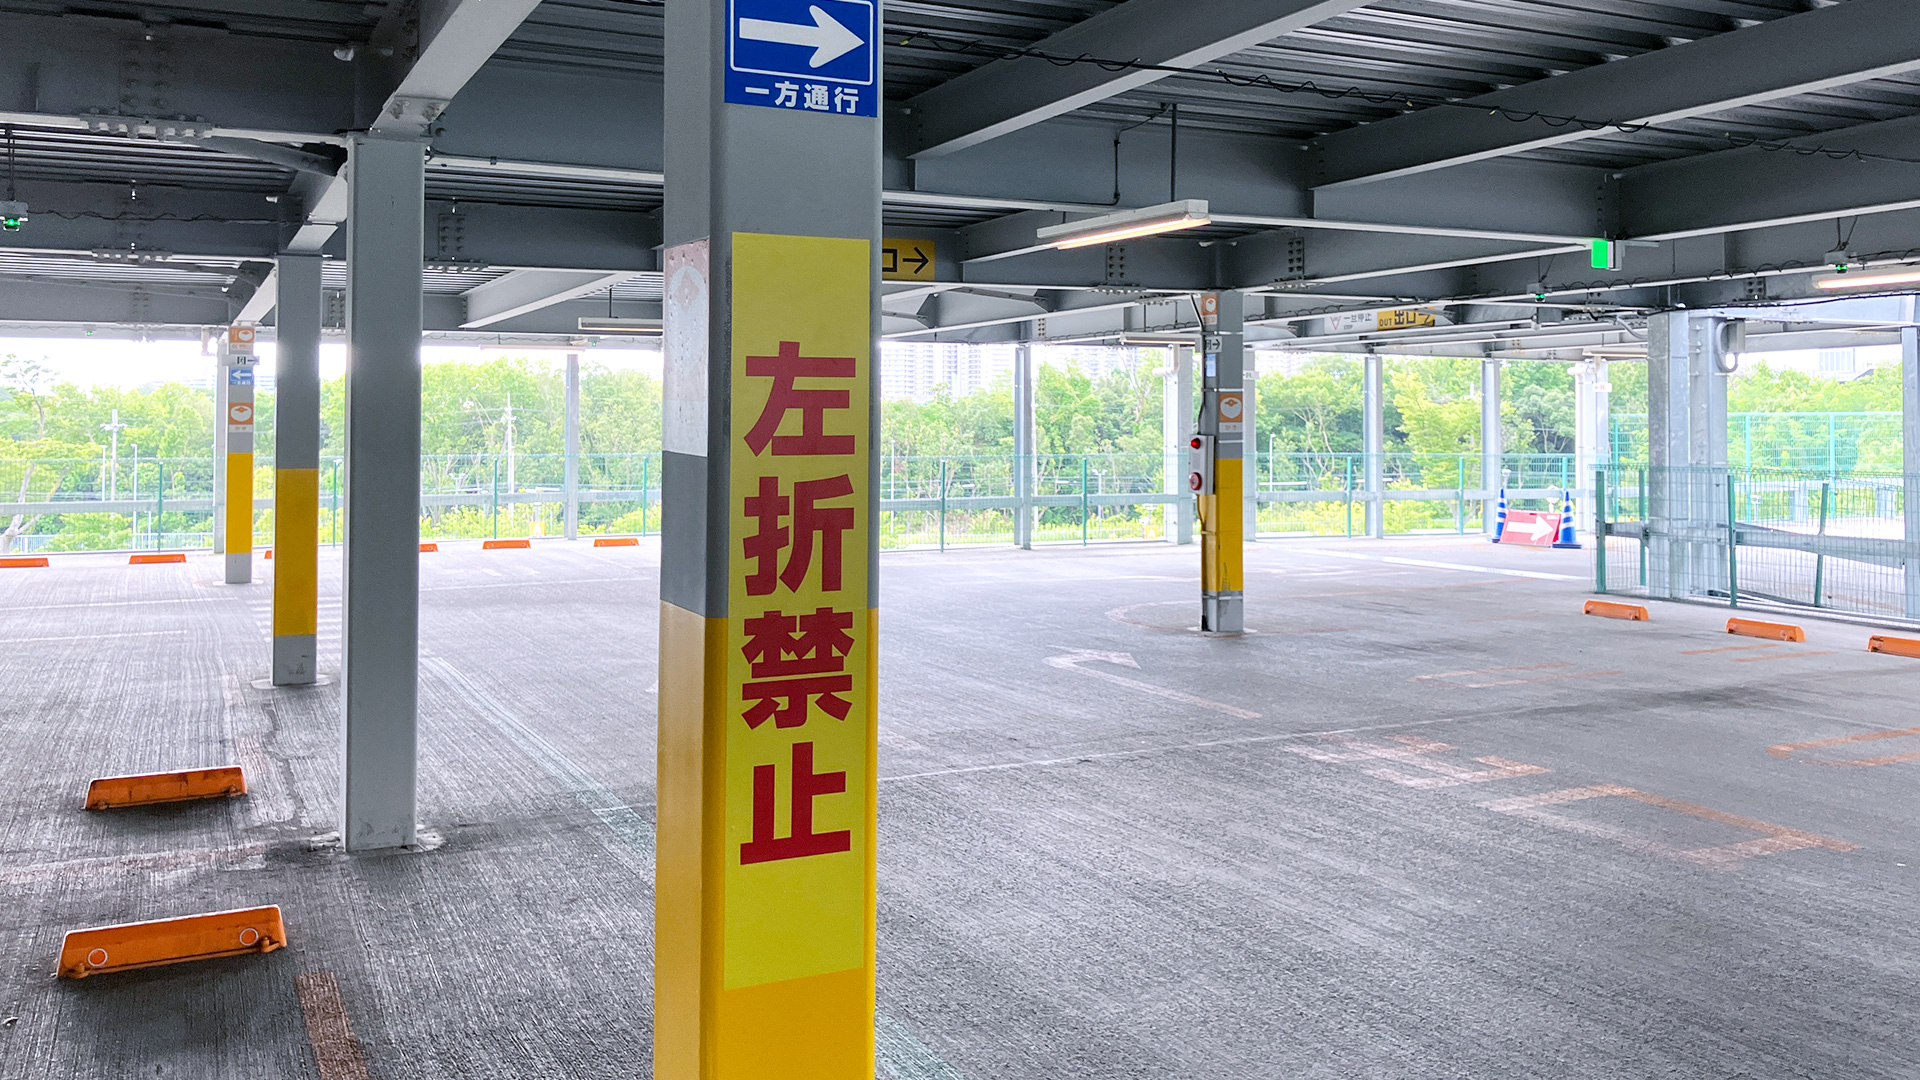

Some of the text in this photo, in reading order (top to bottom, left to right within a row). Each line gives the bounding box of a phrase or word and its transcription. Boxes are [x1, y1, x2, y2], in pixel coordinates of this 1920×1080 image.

[745, 81, 859, 114] 一方通行
[1379, 310, 1416, 327] OUT 出口
[740, 341, 857, 866] 左折禁止
